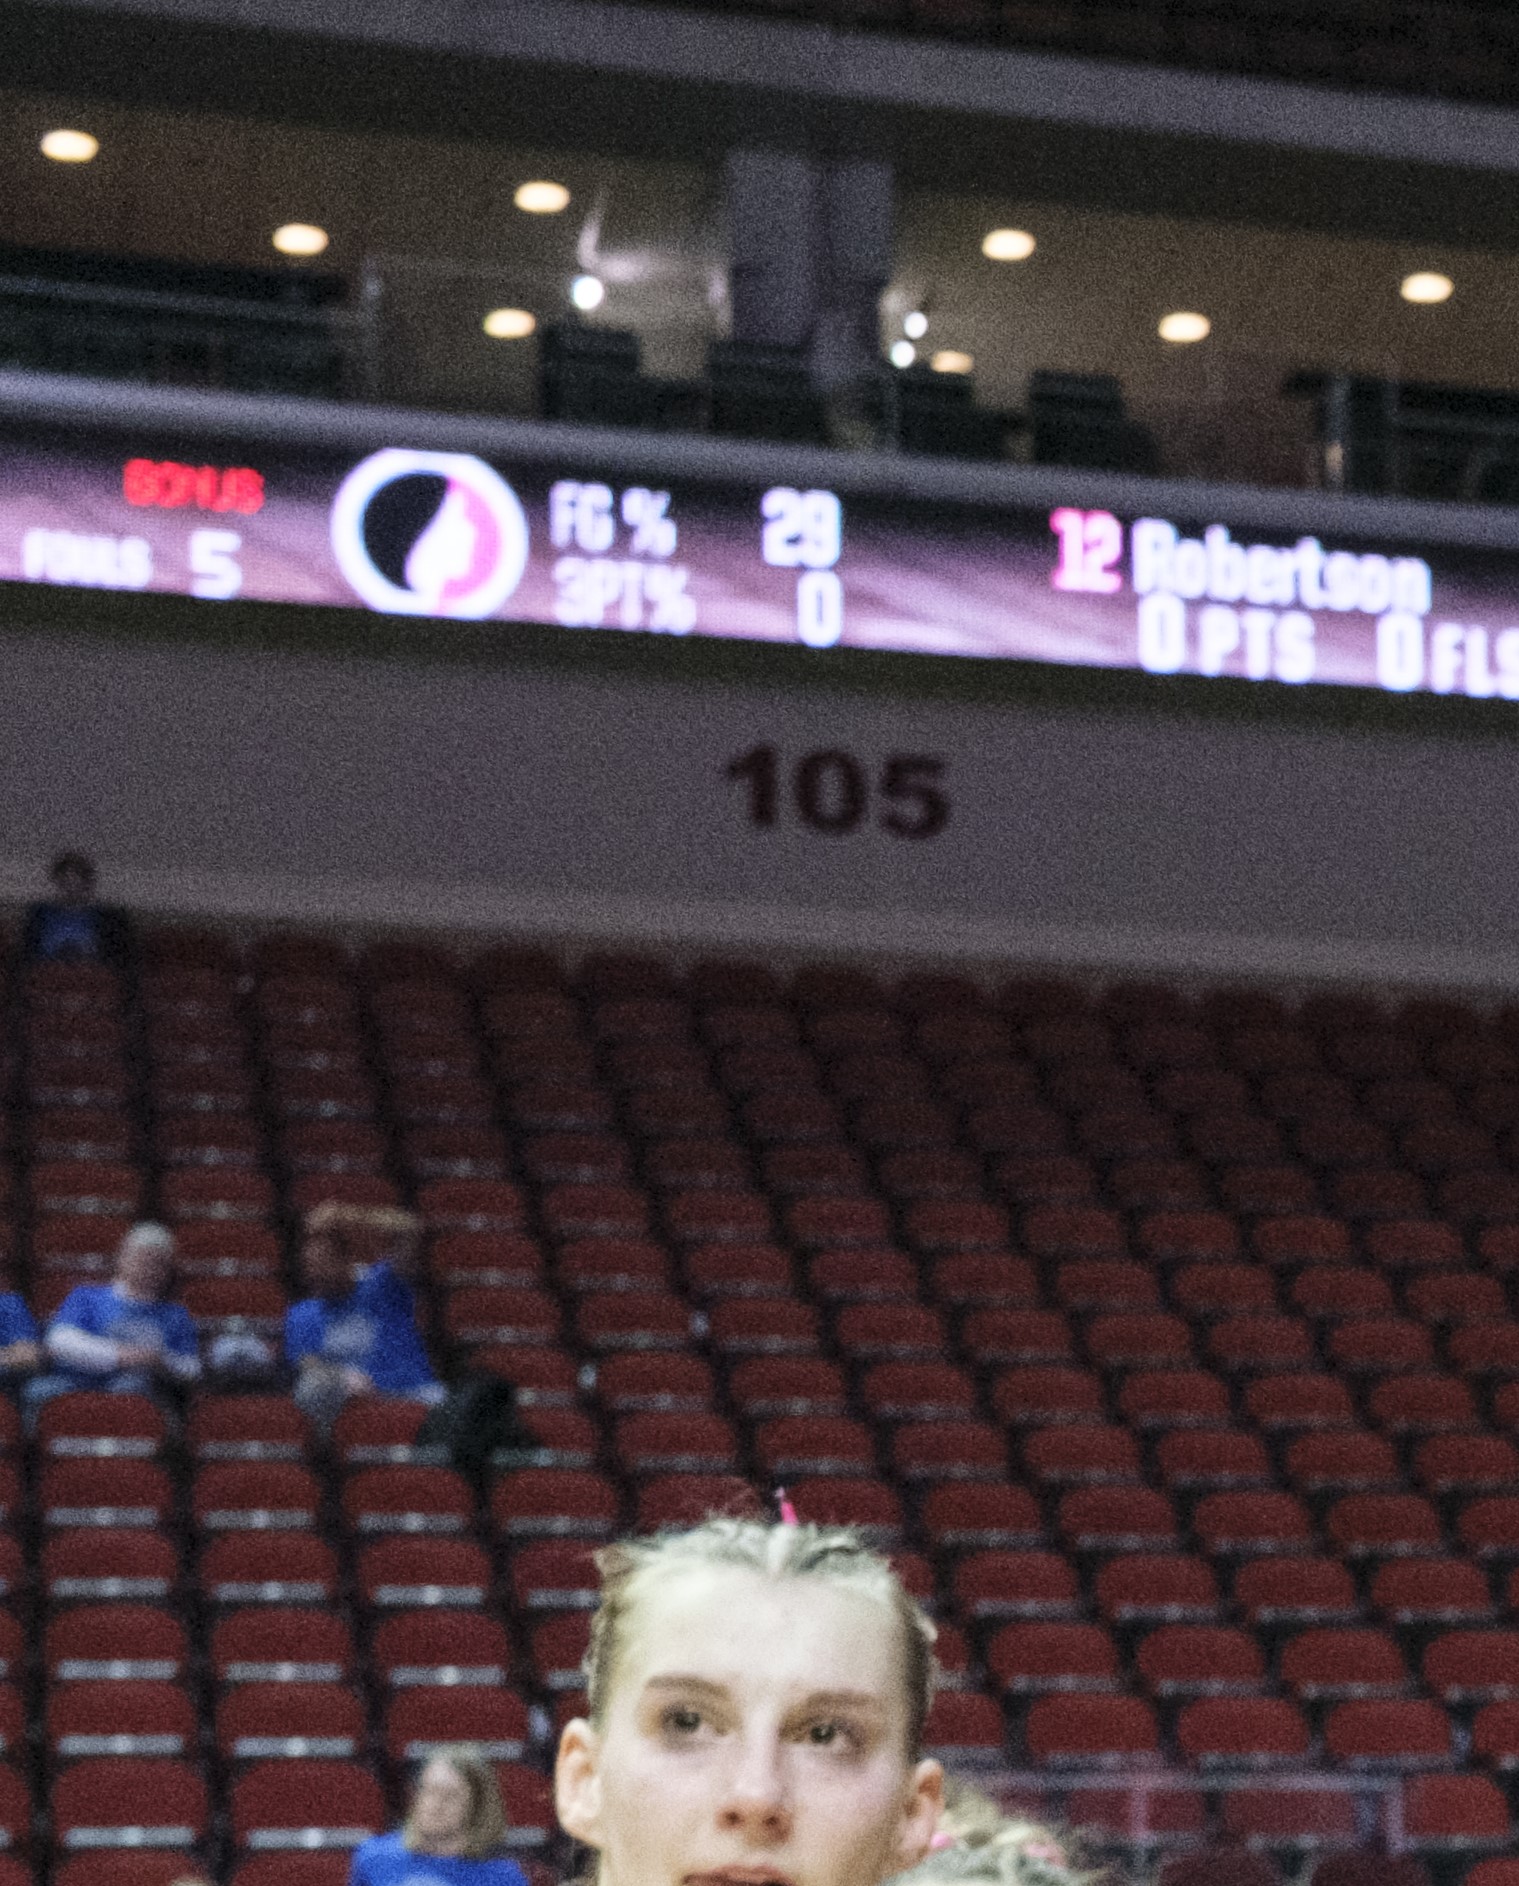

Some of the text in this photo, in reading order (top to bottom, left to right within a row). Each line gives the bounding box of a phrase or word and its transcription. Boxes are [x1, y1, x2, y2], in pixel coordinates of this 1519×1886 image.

[190, 526, 244, 601] 5
[797, 568, 843, 649] 0
[1050, 507, 1432, 617] 12 Robertson
[1137, 590, 1186, 674] 0
[1199, 605, 1316, 684] PTS
[1376, 610, 1424, 692] 0
[725, 745, 952, 840] 105
